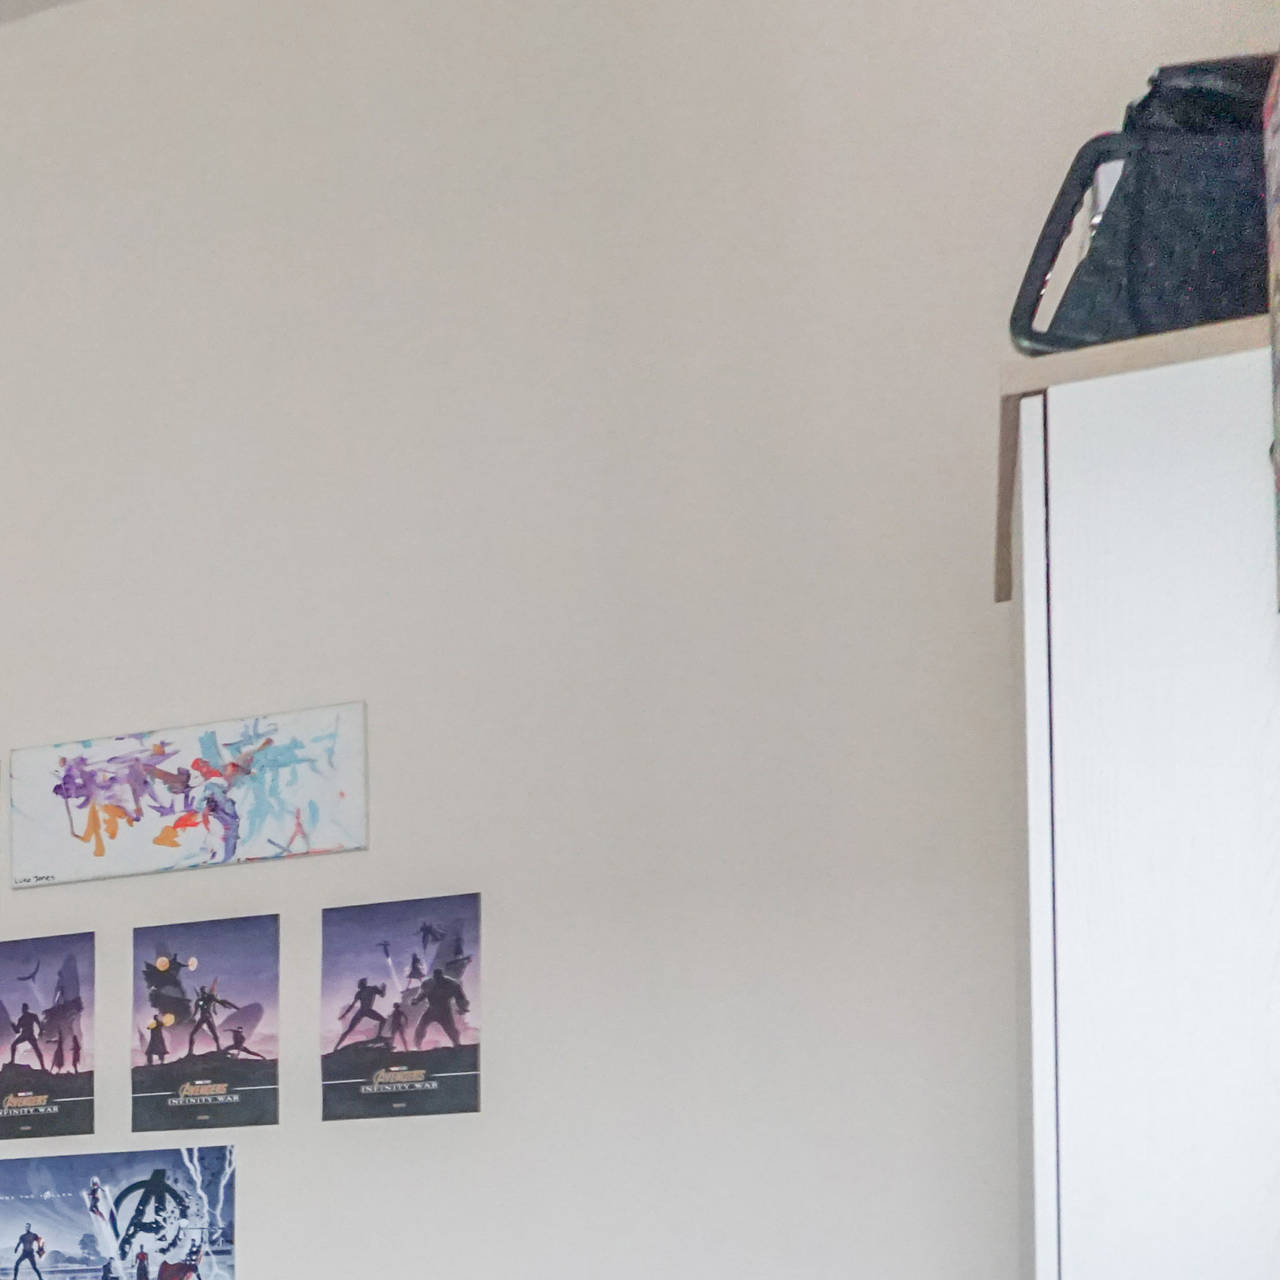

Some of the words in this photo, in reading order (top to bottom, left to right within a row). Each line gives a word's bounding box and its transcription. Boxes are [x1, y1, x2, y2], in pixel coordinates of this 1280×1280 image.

[361, 1083, 410, 1094] INFINITY
[414, 1080, 439, 1090] WAR
[168, 1095, 213, 1106] INFINITY
[216, 1094, 240, 1103] WAR
[38, 1105, 59, 1113] WAR
